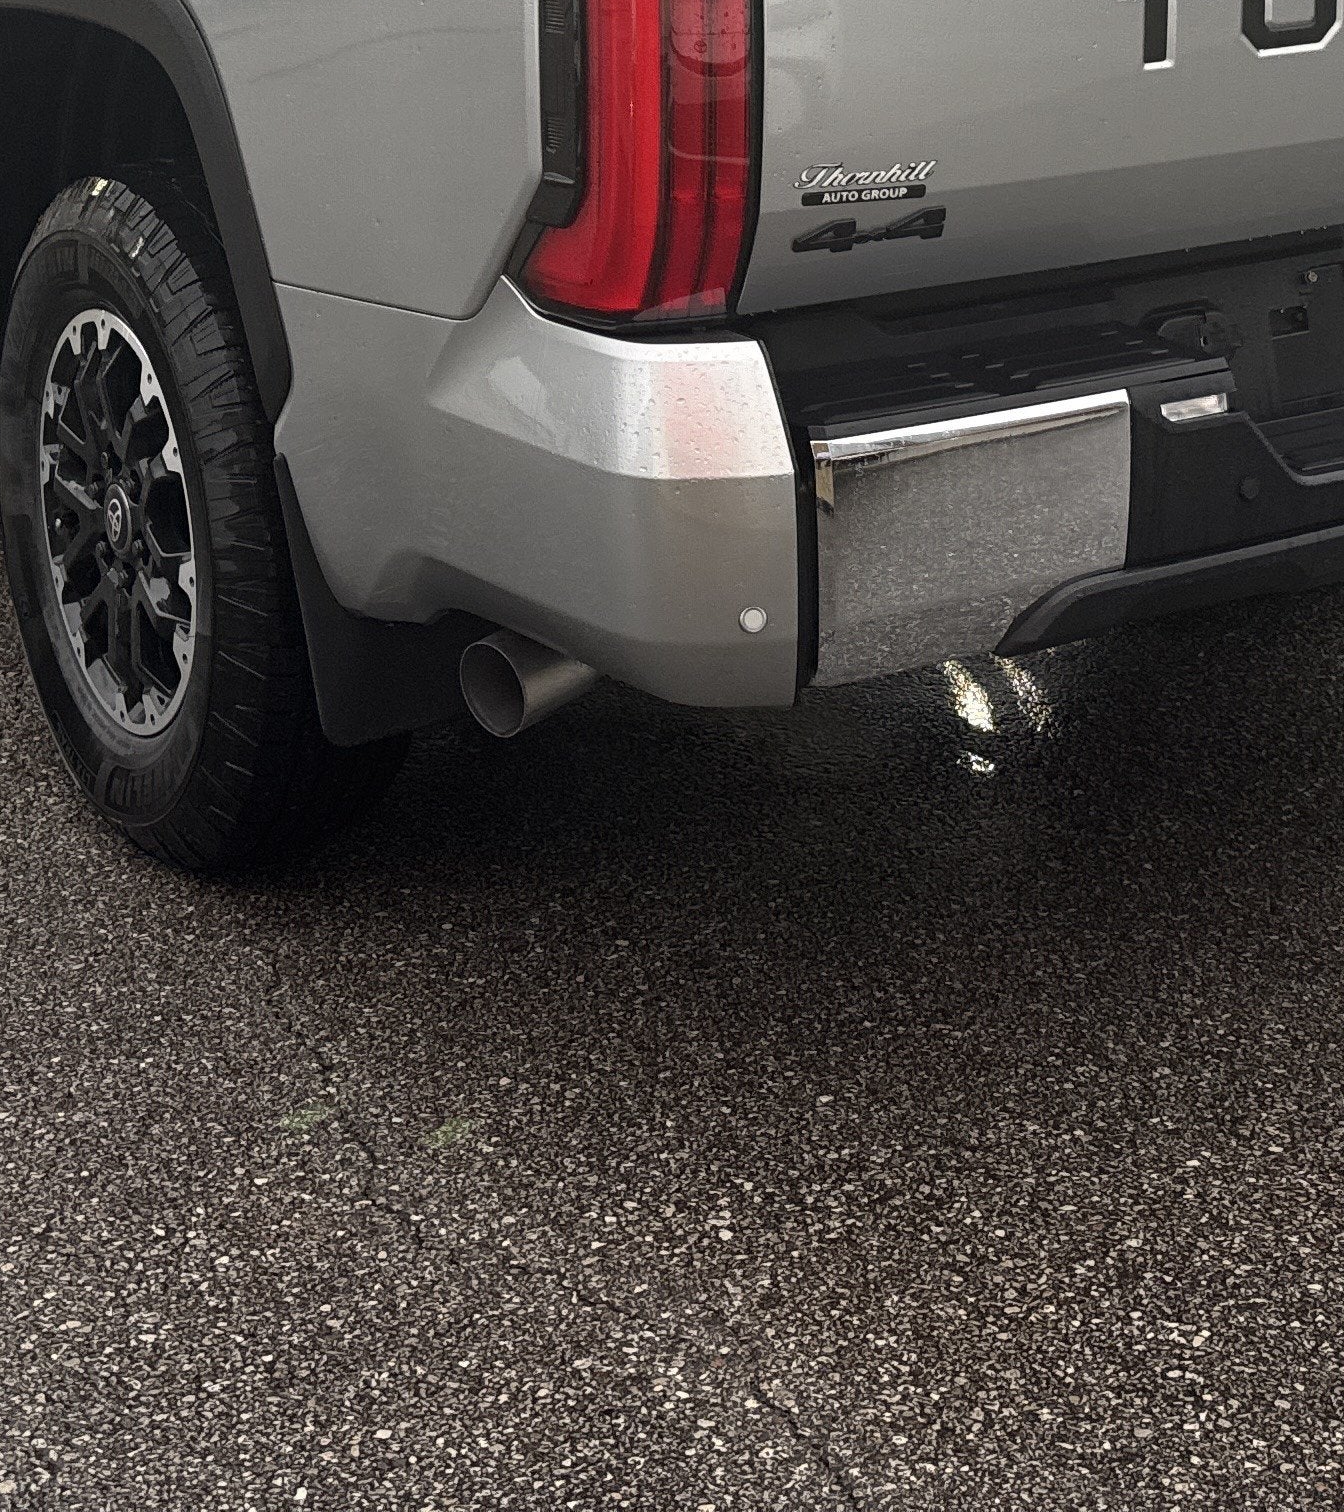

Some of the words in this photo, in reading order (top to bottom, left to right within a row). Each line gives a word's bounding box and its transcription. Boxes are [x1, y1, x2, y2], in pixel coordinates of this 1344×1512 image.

[793, 159, 939, 188] Thornhill
[822, 190, 859, 204] AUTO
[861, 187, 908, 201] GROUP
